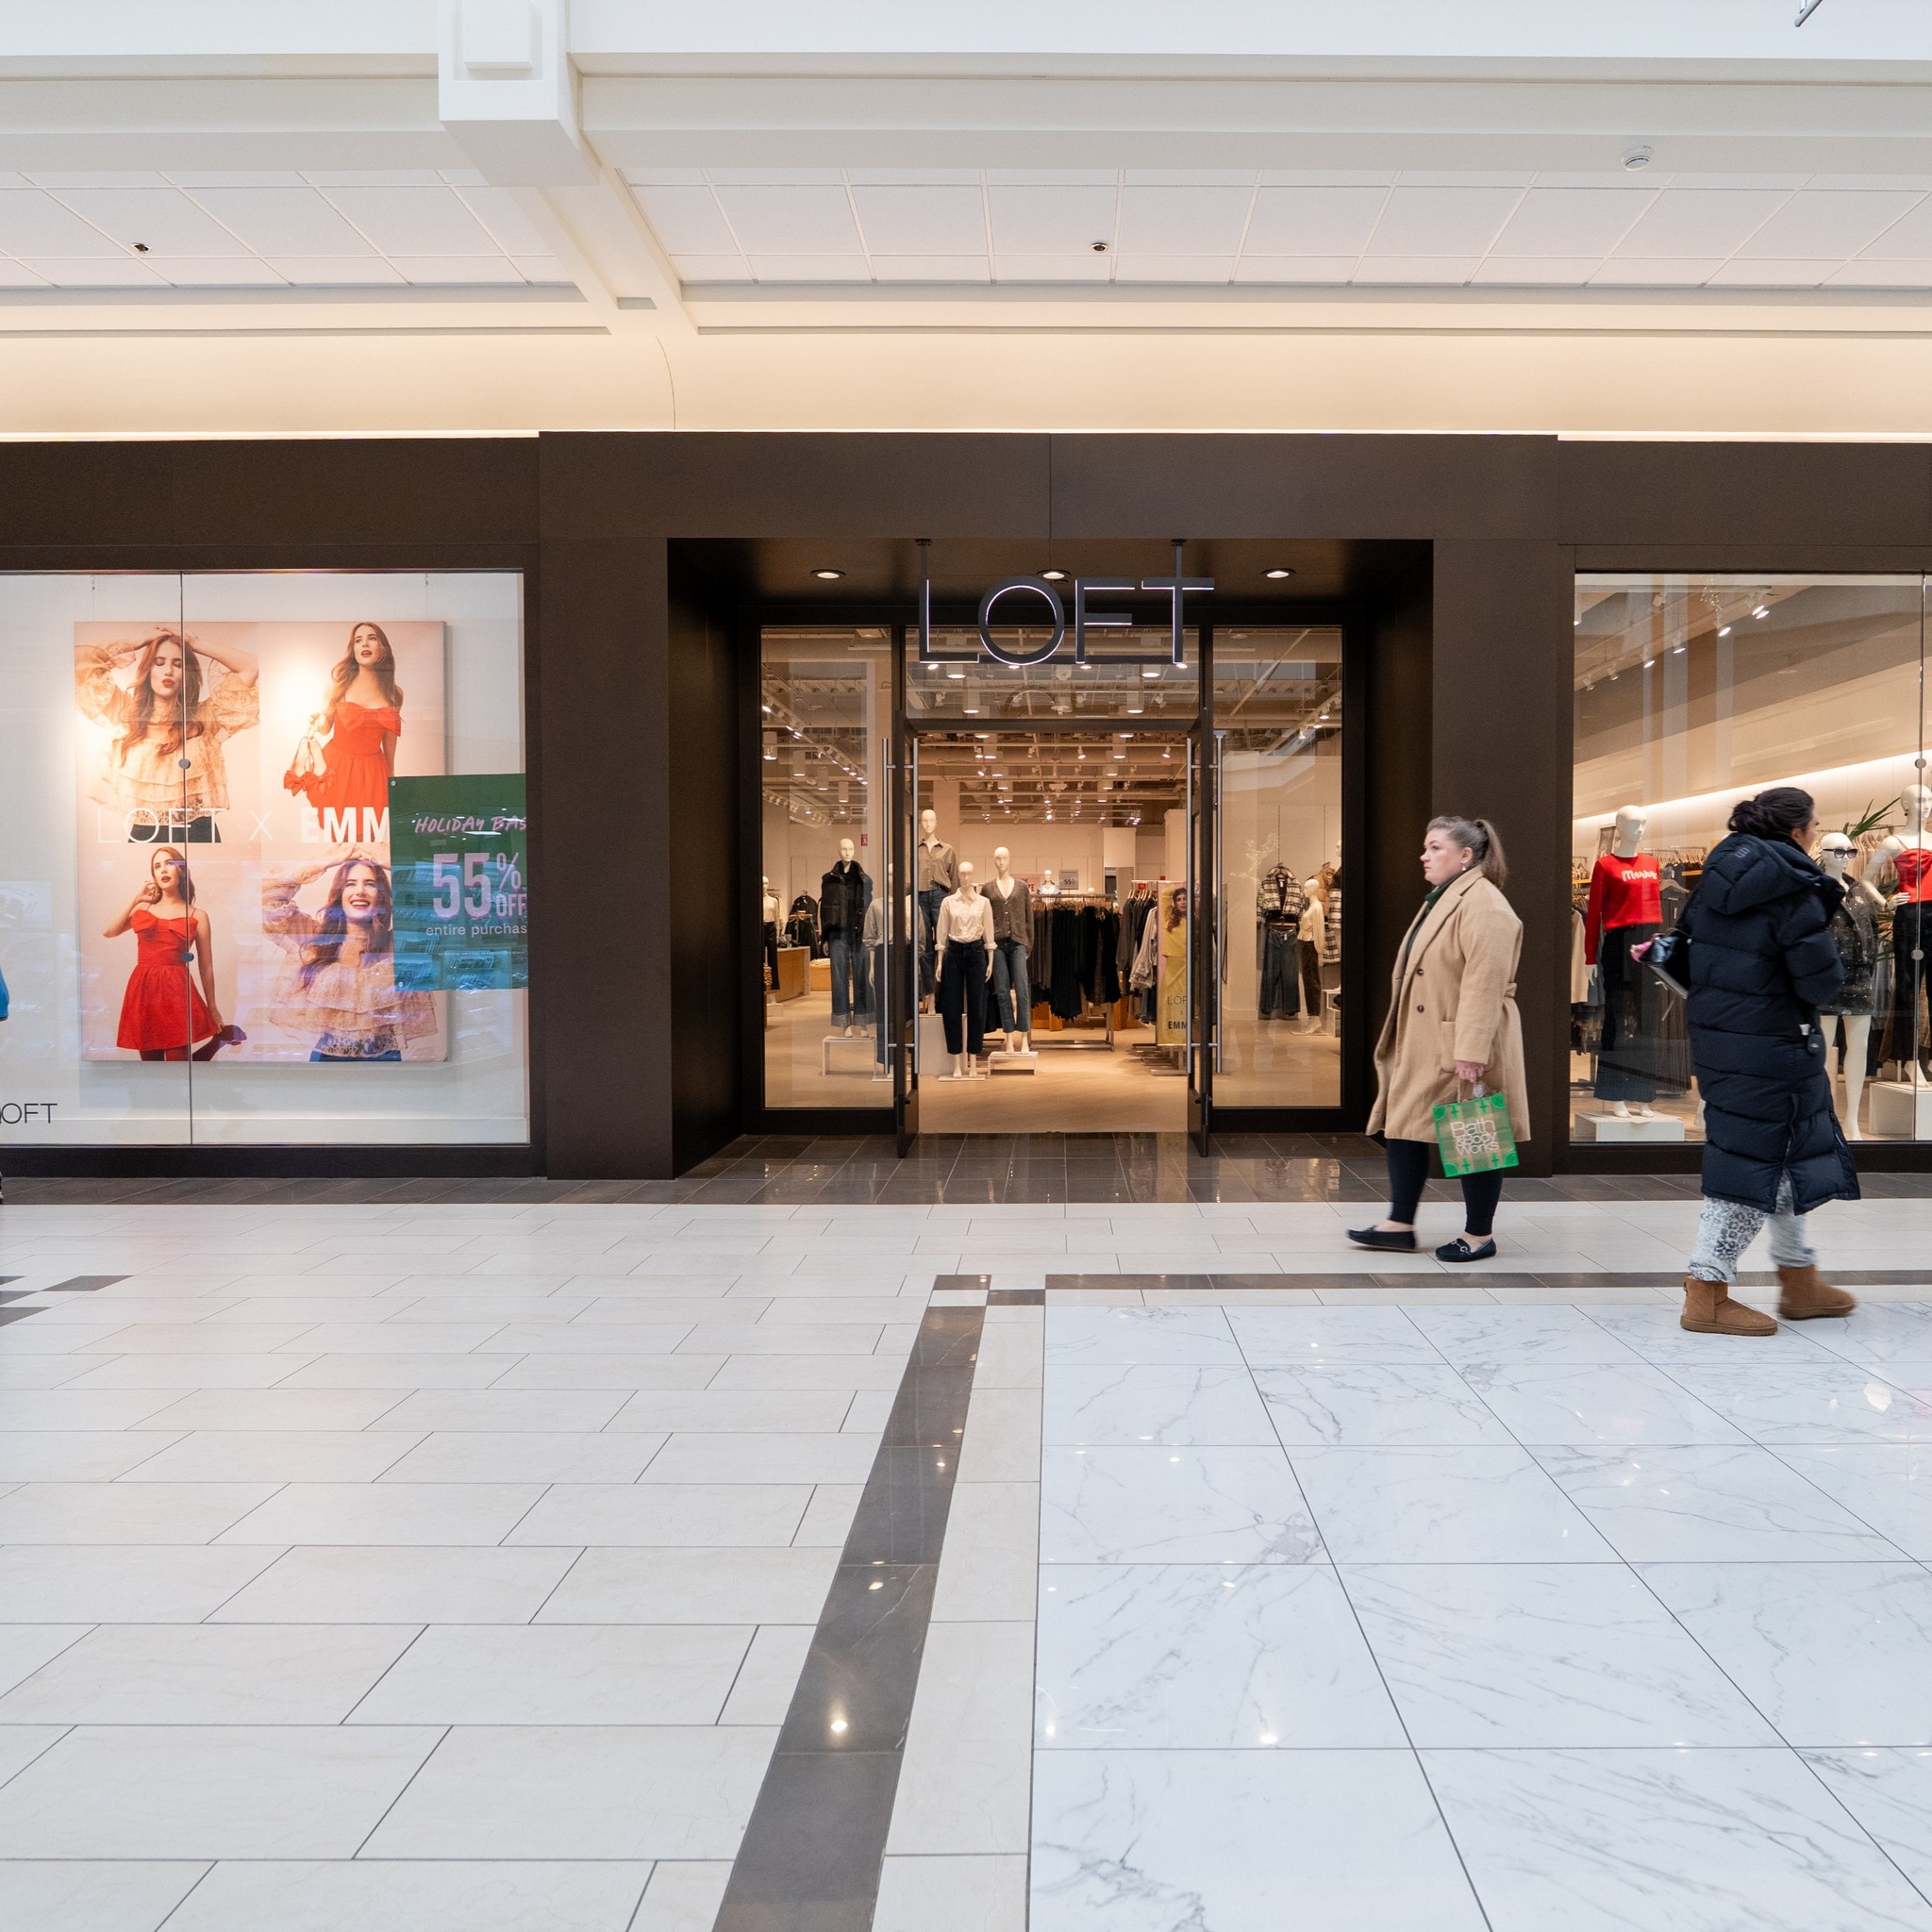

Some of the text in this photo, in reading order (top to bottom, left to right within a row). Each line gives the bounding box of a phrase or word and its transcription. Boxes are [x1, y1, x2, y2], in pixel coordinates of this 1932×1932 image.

[920, 576, 1215, 666] LOFT
[97, 806, 391, 843] LOFT X EMM
[414, 816, 485, 834] HOLIDAY
[495, 893, 527, 918] OFF
[425, 923, 527, 938] entire purchas
[0, 1103, 58, 1124] OFT
[1450, 1118, 1496, 1139] Bath
[1455, 1141, 1500, 1156] Works
